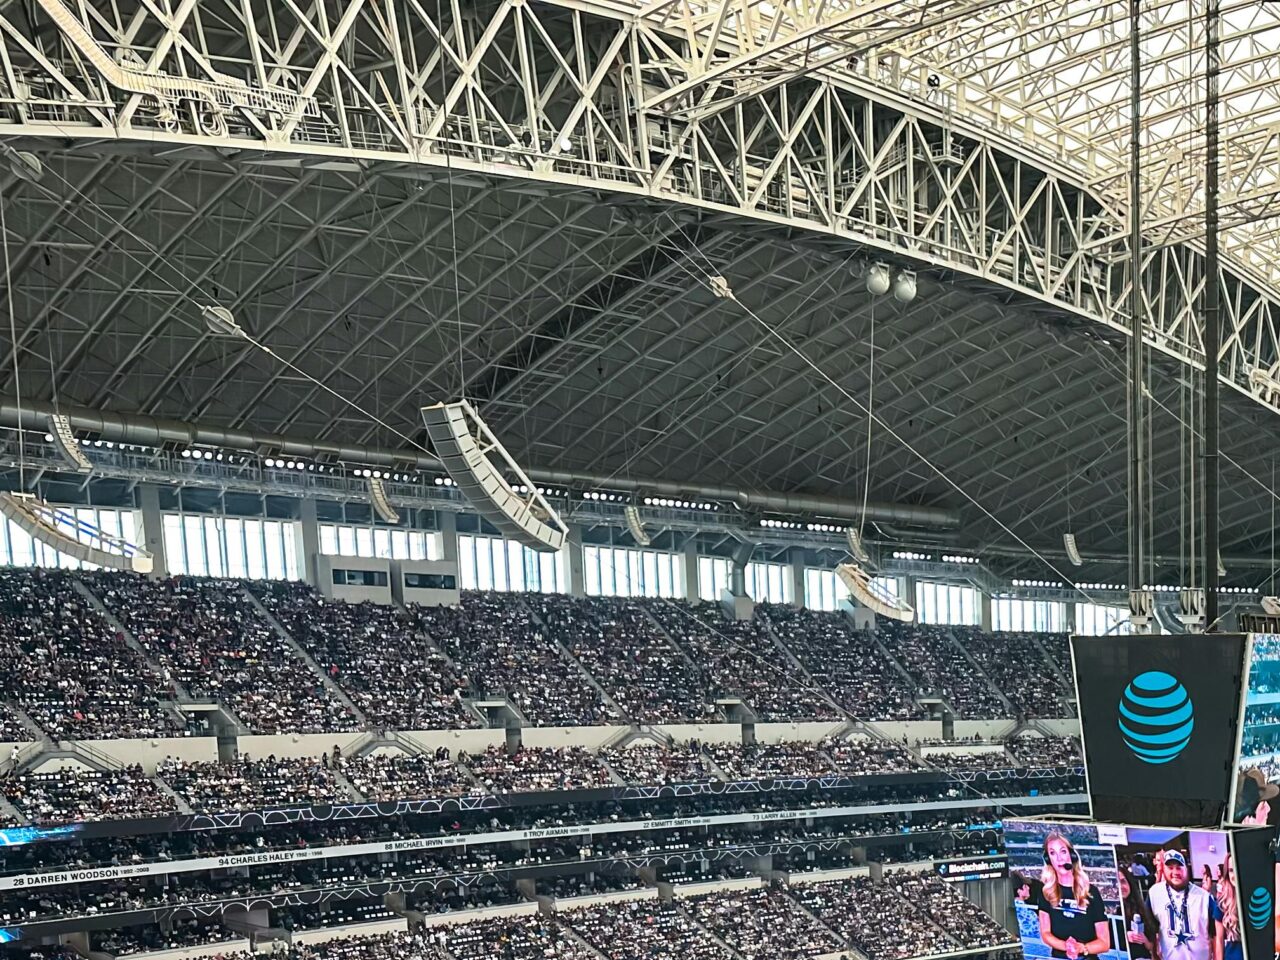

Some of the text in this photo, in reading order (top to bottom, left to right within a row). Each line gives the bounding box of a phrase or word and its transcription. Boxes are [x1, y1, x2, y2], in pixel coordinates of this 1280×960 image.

[761, 812, 780, 820] LARRY
[780, 811, 797, 819] ALLEN
[651, 820, 673, 828] EMMITT
[529, 830, 545, 838] TROY
[395, 840, 424, 849] MICHAEL
[425, 838, 443, 847] IRVIN
[218, 858, 229, 866] 94
[230, 854, 268, 865] CHARLES
[269, 852, 294, 862] HALEY
[949, 861, 1005, 874] Blockchain.com
[13, 878, 24, 886] 28
[27, 874, 67, 885] DARREN
[70, 869, 119, 882] WOODSON
